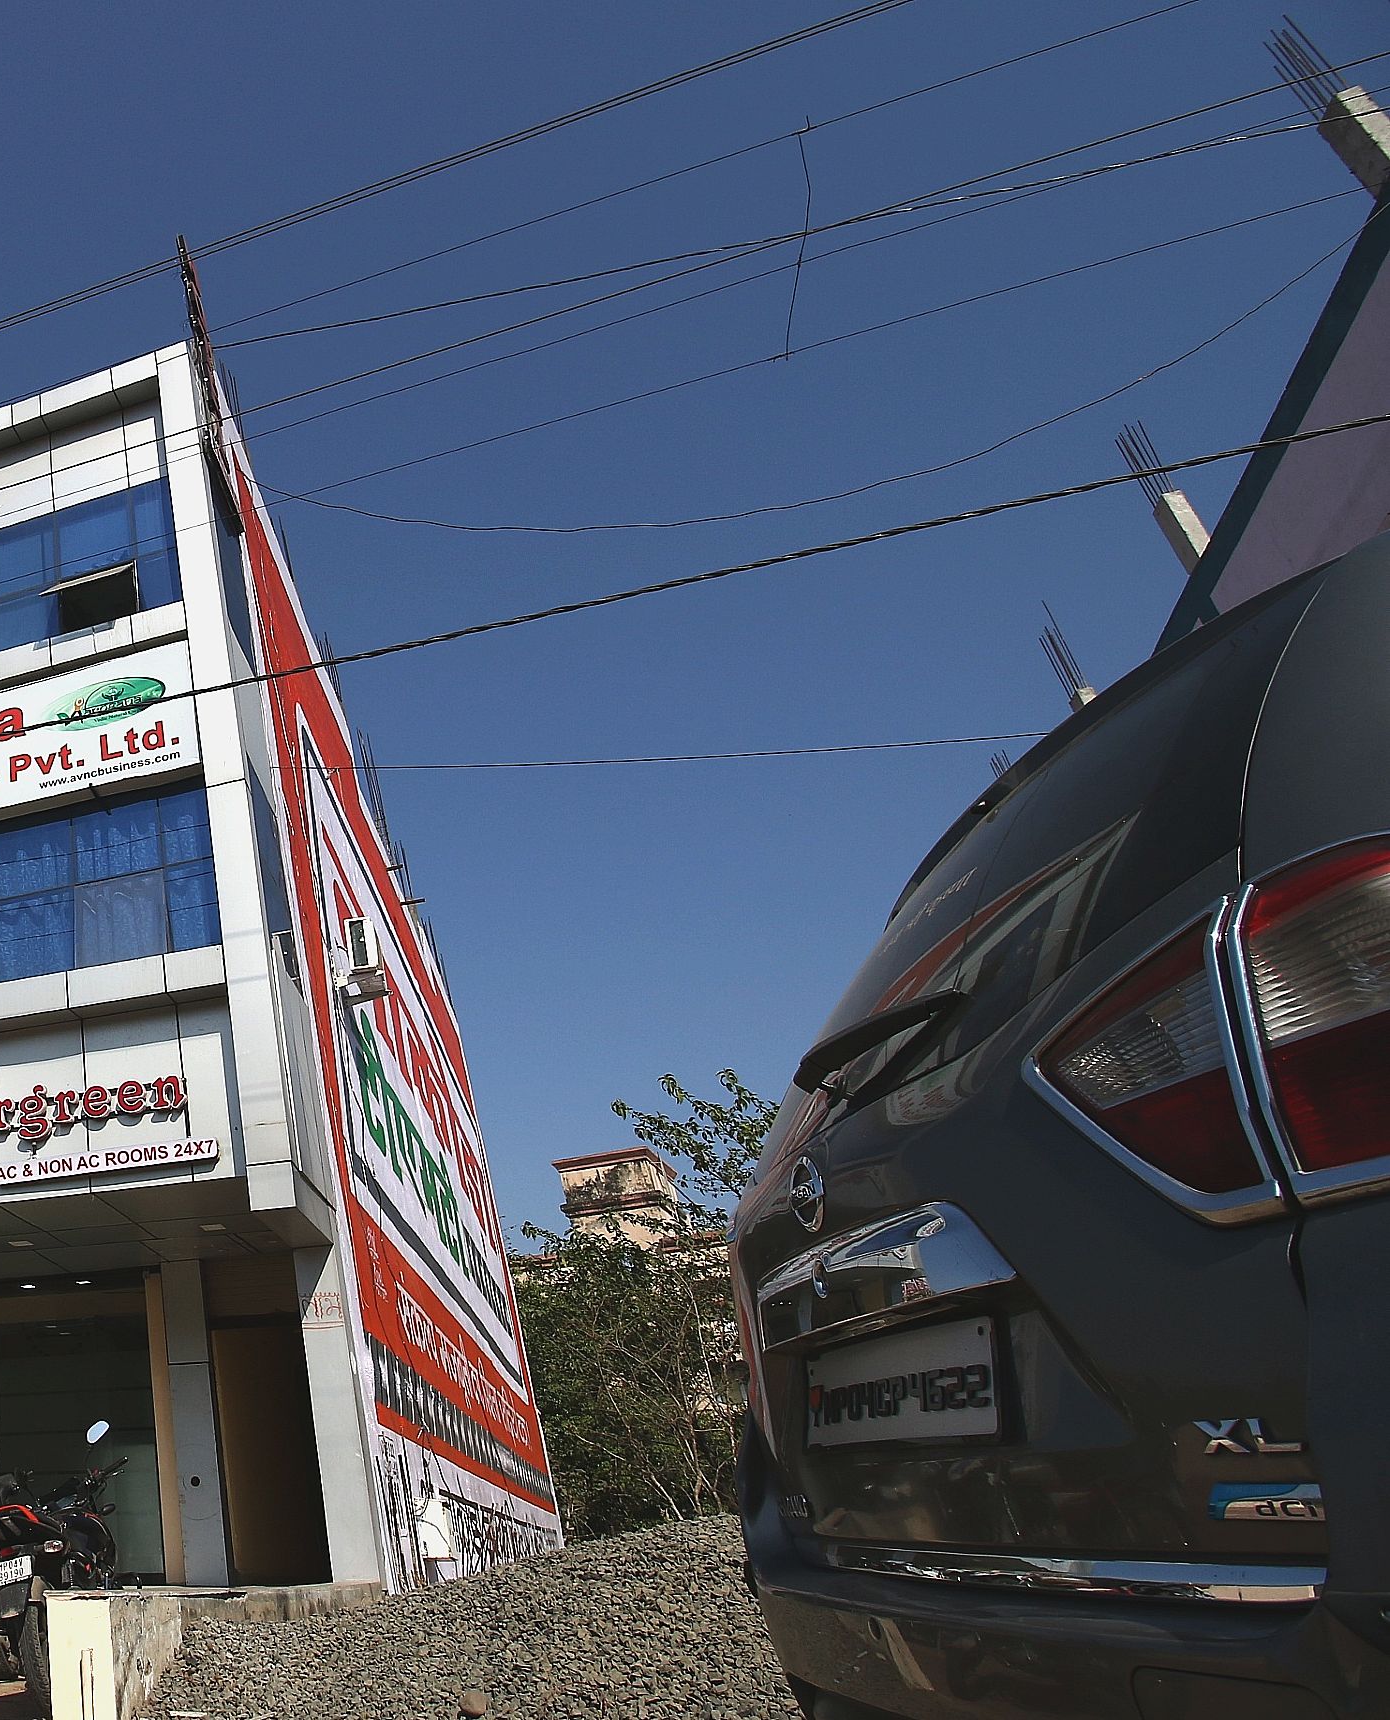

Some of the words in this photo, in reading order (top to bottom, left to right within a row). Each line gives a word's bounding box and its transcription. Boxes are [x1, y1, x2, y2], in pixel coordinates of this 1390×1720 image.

[10, 743, 84, 782] Pvt.
[100, 721, 179, 761] Ltd.
[39, 751, 181, 789] www.avncbusiness.com
[23, 1163, 33, 1177] &
[38, 1157, 73, 1175] NON
[77, 1154, 100, 1172] AC
[106, 1145, 168, 1166] ROOMS
[174, 1139, 214, 1158] 24X7
[1192, 1418, 1304, 1454] XL
